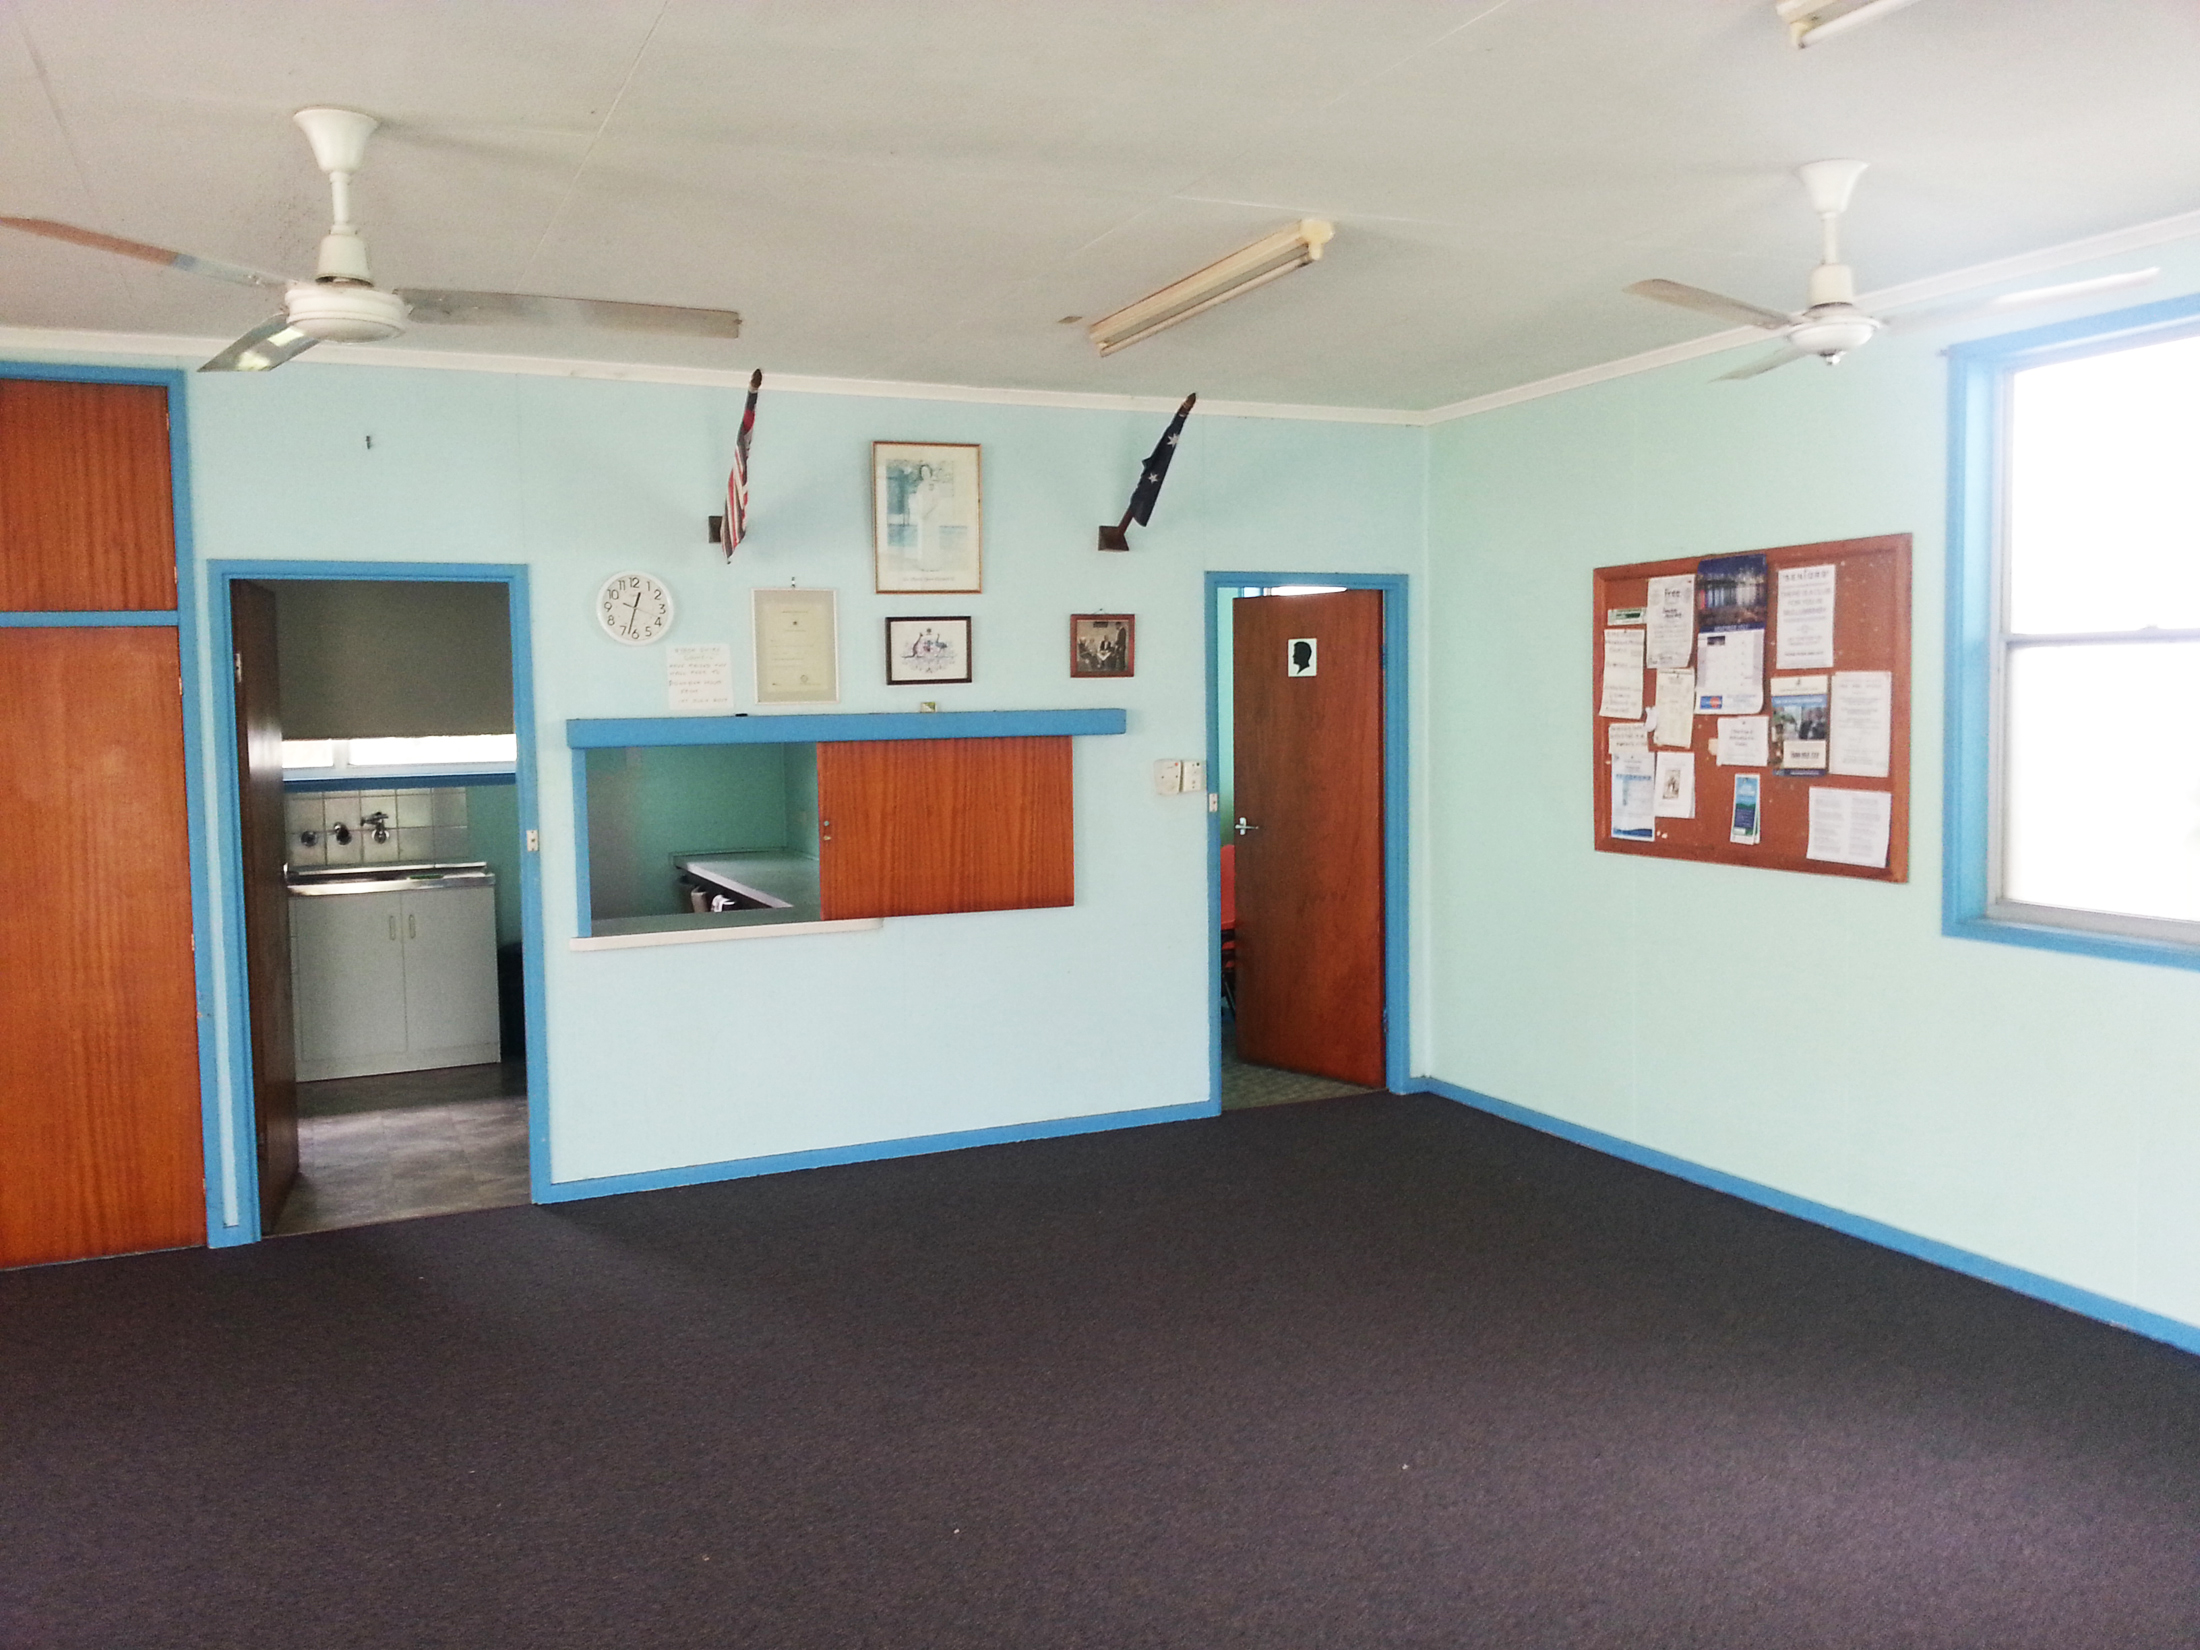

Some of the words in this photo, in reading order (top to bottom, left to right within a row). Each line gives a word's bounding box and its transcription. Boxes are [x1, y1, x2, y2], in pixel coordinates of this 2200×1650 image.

[618, 580, 626, 591] 11
[629, 577, 640, 588] 12
[607, 589, 620, 600] 10
[654, 589, 662, 600] 2
[604, 601, 612, 612] 9
[659, 603, 666, 614] 3
[607, 615, 615, 626] 8
[654, 616, 662, 627] 4
[620, 625, 627, 636] 7
[631, 629, 640, 640] 6
[645, 626, 652, 637] 5
